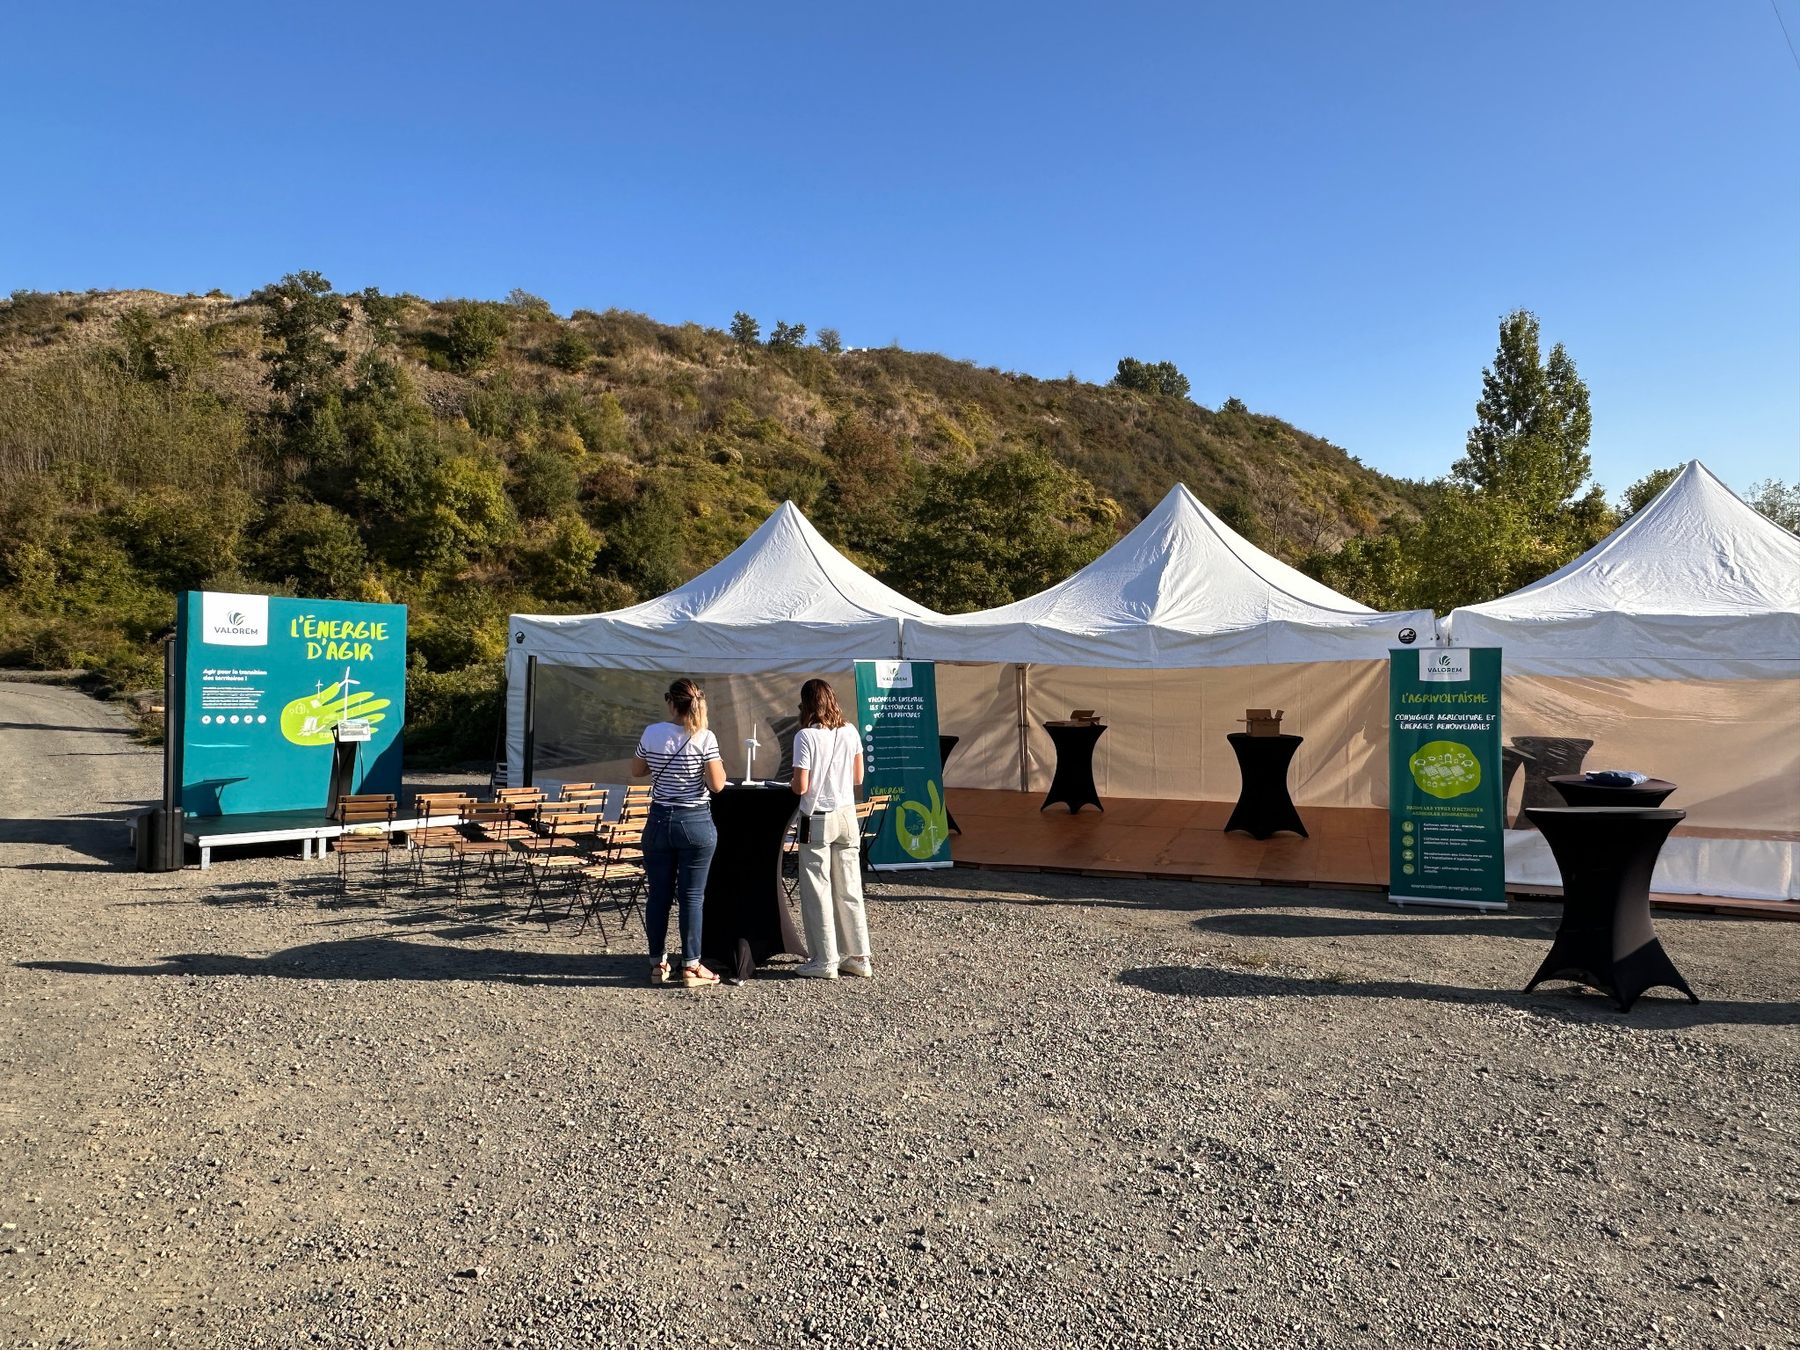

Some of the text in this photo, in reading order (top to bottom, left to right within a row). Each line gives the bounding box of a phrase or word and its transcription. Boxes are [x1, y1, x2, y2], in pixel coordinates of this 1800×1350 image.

[214, 626, 258, 635] VALOREM
[290, 614, 389, 640] L'ÉNERGIE
[306, 638, 374, 661] D'AGIR
[1401, 691, 1489, 704] L'AGRIVOLTAÏSME
[1394, 713, 1496, 721] CONJUGUER AGRICULTURE ET
[1400, 720, 1490, 731] ÉNERGIES RENOUVELABLES
